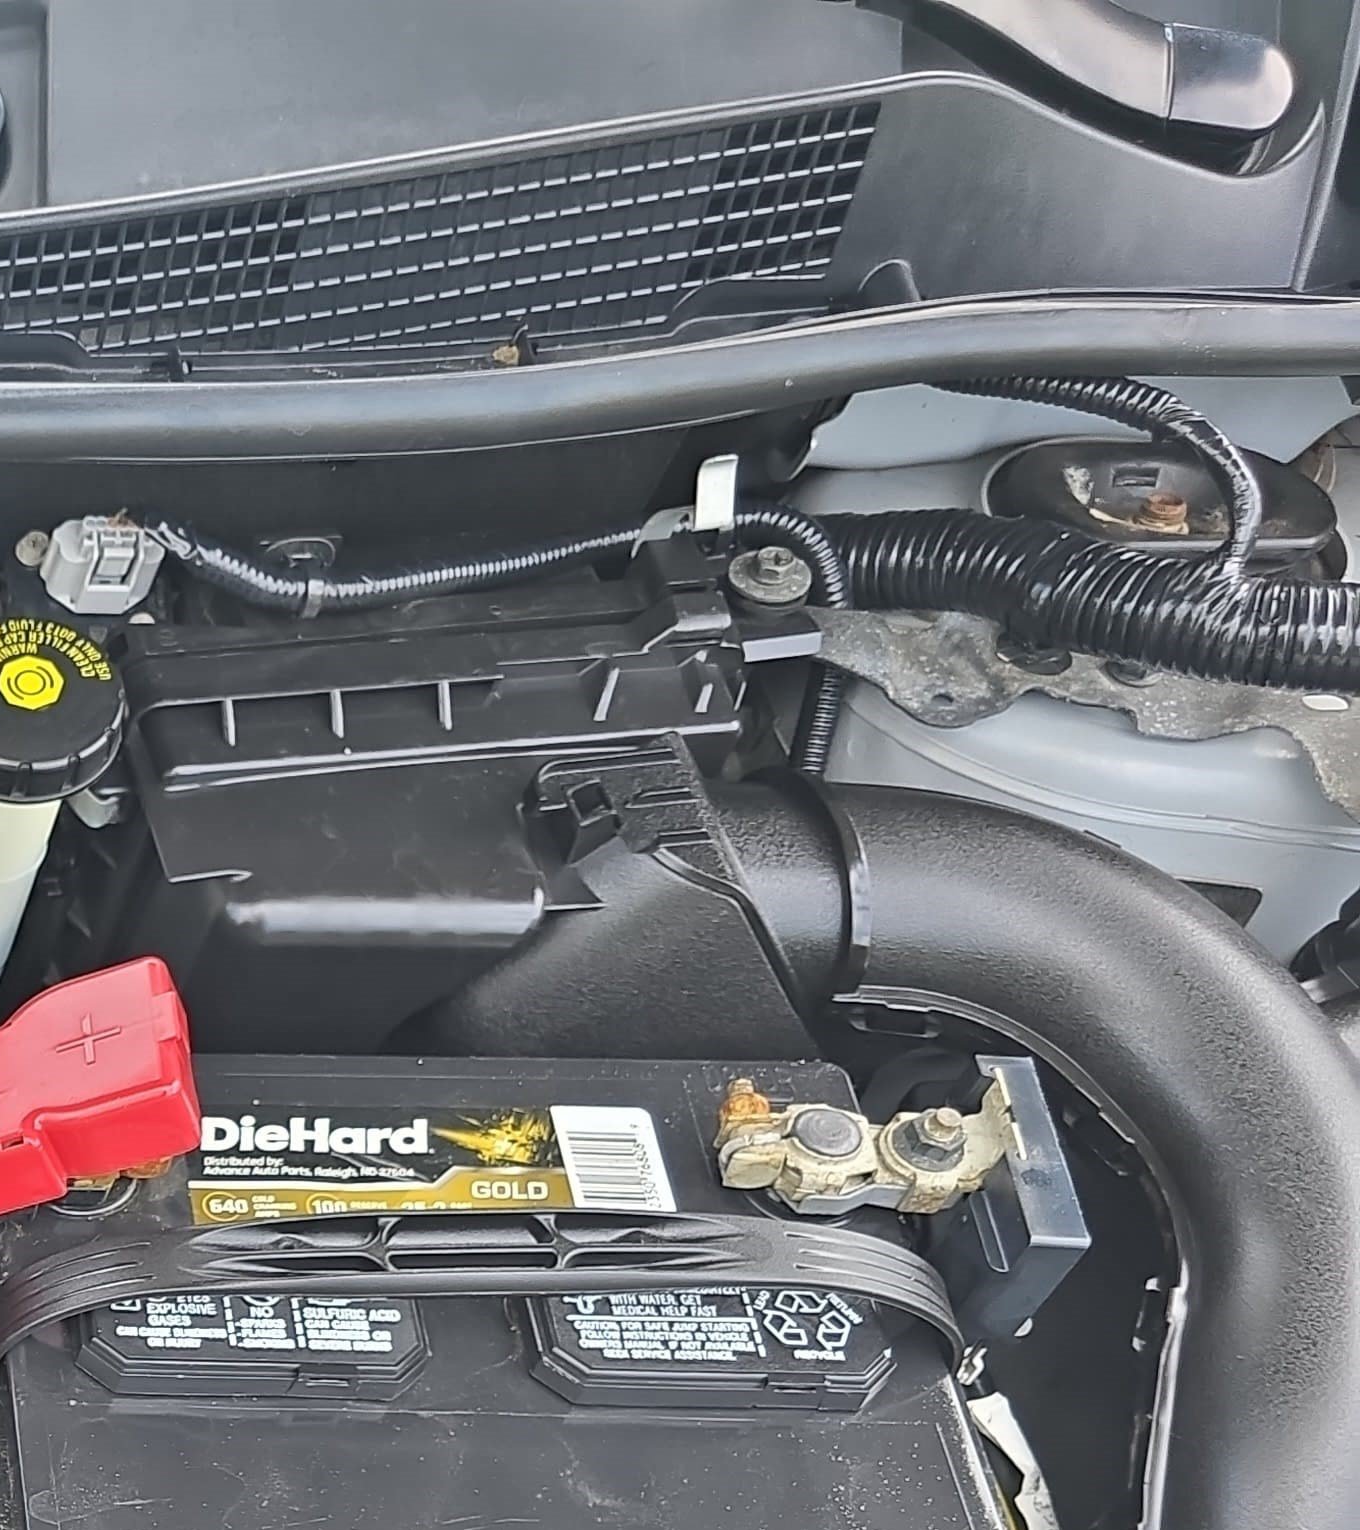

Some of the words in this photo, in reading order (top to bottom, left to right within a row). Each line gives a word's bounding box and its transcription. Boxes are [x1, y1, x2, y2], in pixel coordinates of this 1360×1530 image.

[4, 631, 26, 645] CAP
[200, 1115, 429, 1155] DieHard
[203, 1156, 265, 1166] Distributed
[266, 1156, 284, 1168] by:
[203, 1166, 251, 1176] Advance
[252, 1166, 279, 1176] Auto
[471, 1181, 549, 1200] GOLD
[208, 1198, 249, 1214] 640
[608, 1293, 637, 1305] WITH
[680, 1294, 701, 1306] GET
[146, 1302, 218, 1316] EXPLOSIVE
[250, 1306, 275, 1318] NO
[302, 1306, 367, 1320] SULFURIC
[368, 1308, 401, 1322] ACID
[611, 1305, 659, 1316] MEDICAL
[660, 1305, 688, 1316] HELP
[690, 1305, 717, 1317] FAST
[147, 1314, 192, 1327] GASES
[700, 1322, 750, 1332] STARTING
